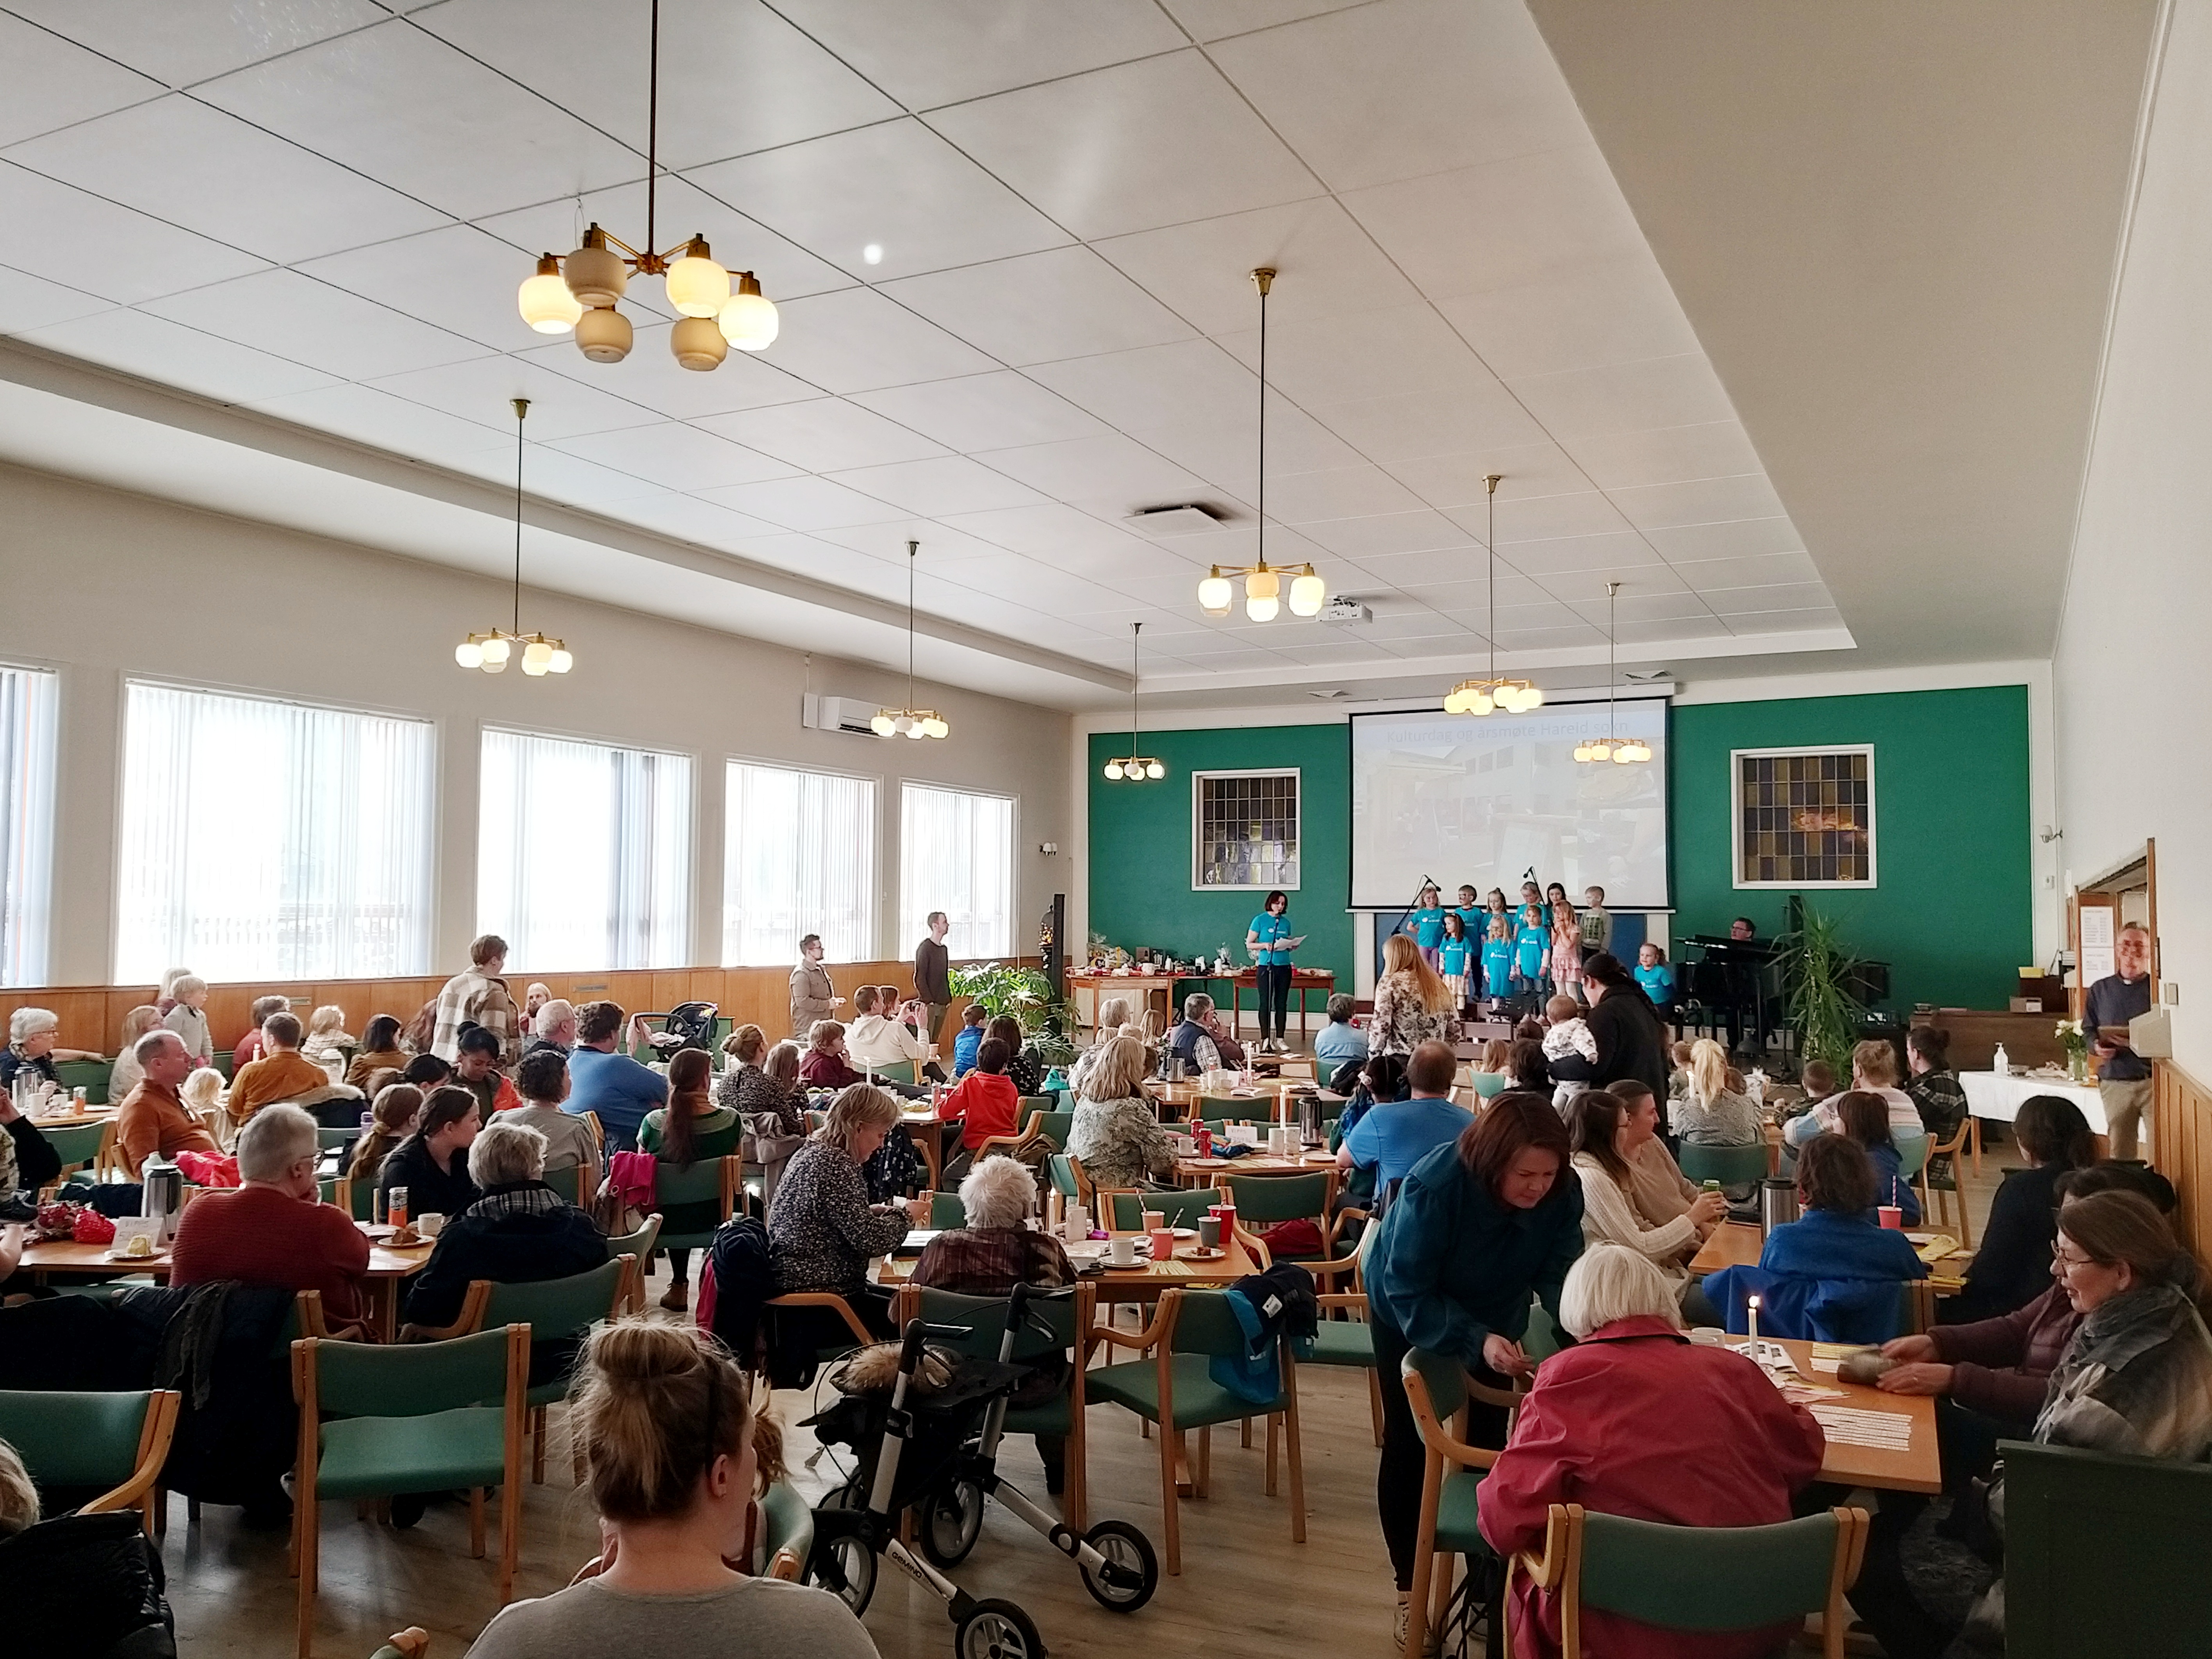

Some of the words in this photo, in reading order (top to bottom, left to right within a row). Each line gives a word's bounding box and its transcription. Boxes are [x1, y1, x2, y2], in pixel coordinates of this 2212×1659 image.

[1387, 729, 1453, 742] Kulturdag
[1457, 730, 1473, 742] og
[1477, 725, 1536, 738] årsmøte
